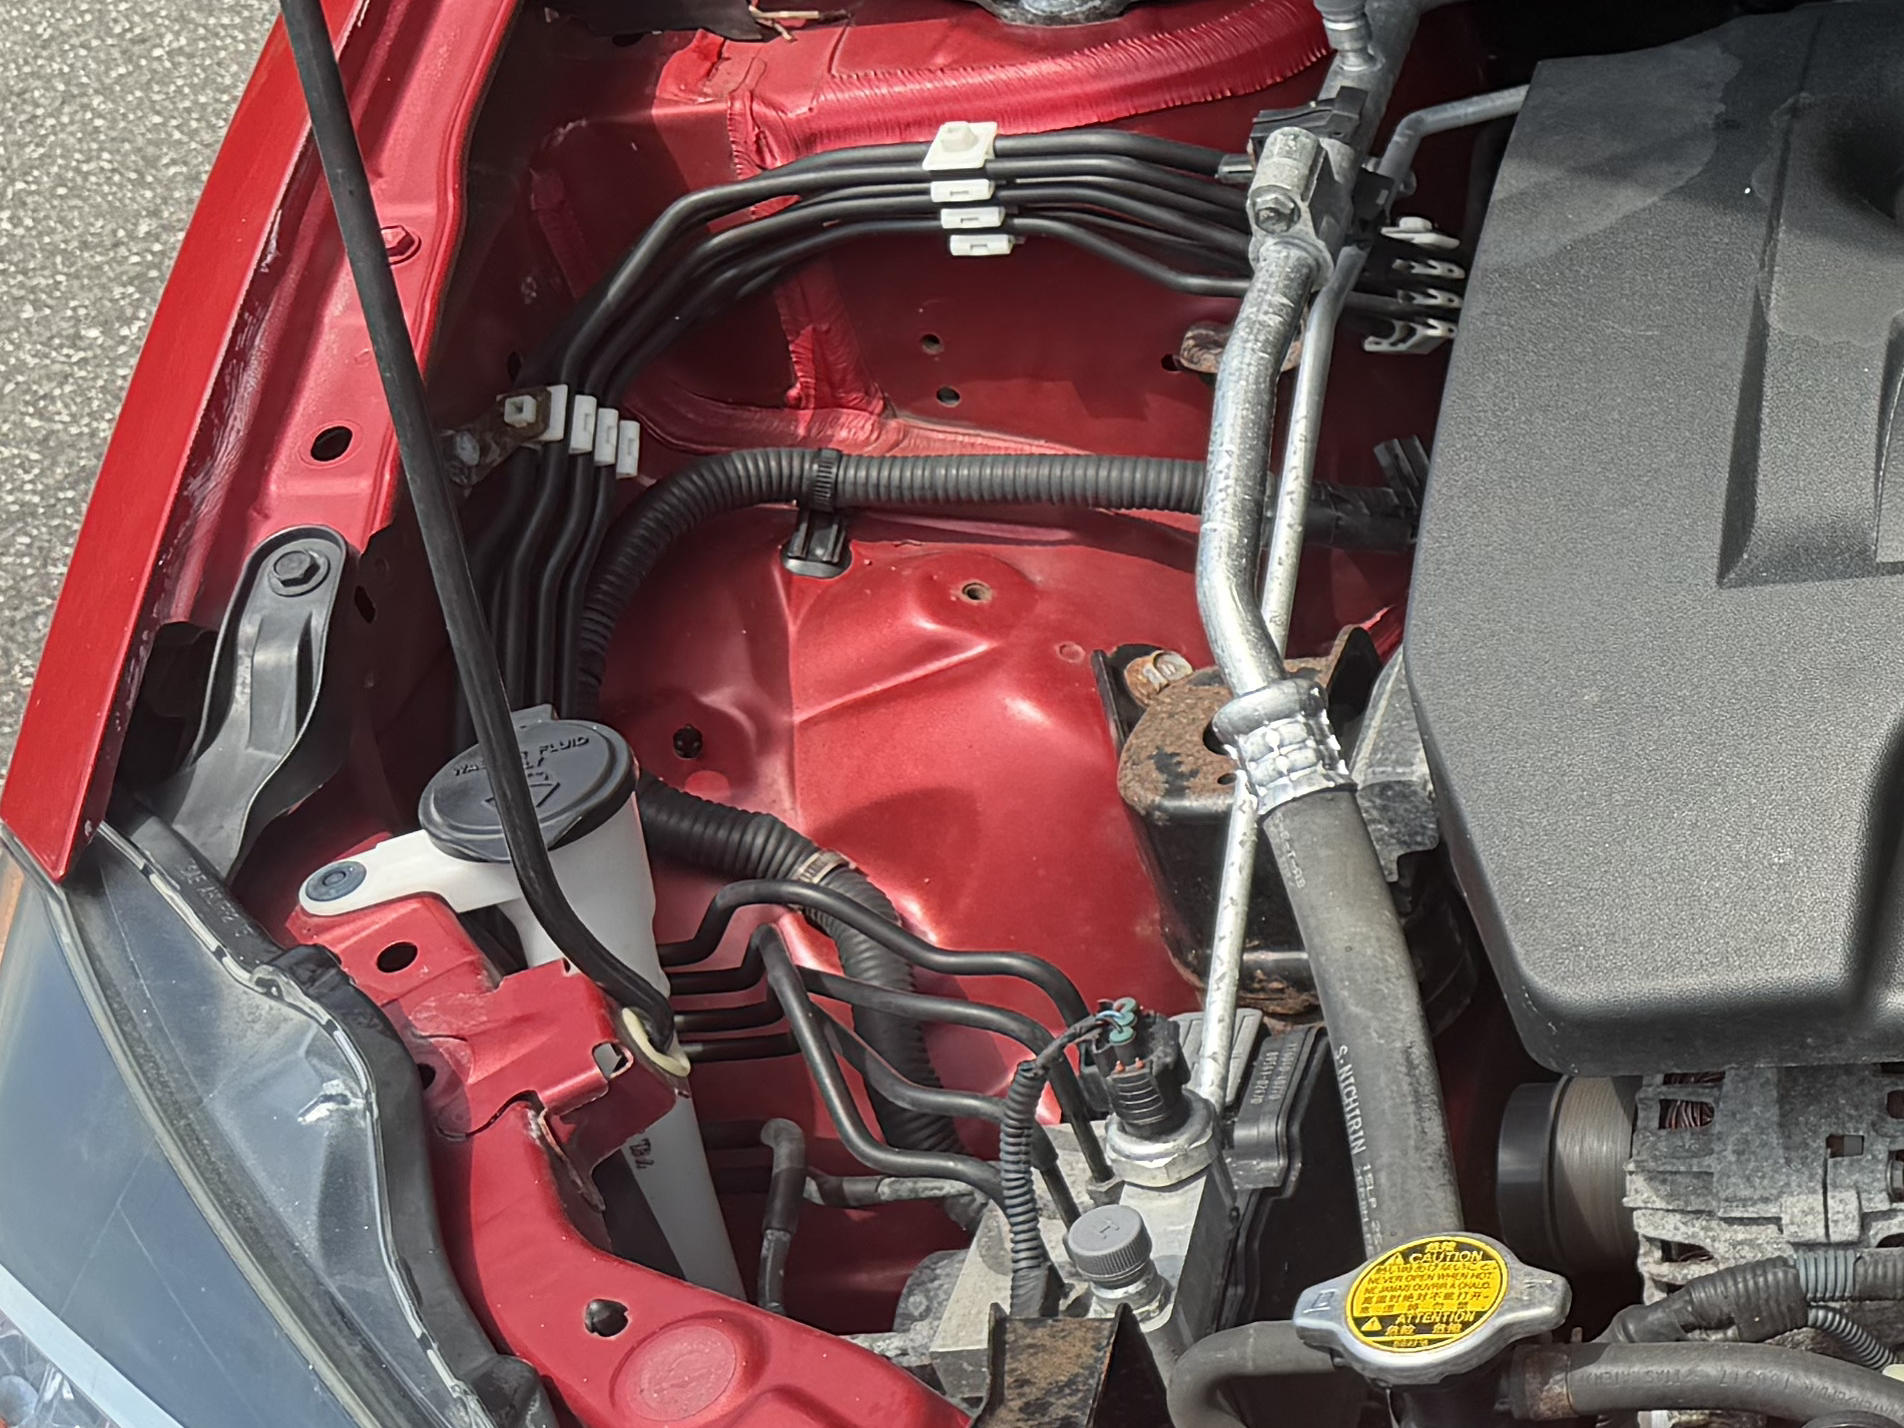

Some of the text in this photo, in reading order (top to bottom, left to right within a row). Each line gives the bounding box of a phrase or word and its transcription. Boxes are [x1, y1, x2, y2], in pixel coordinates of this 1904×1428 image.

[539, 736, 590, 756] FLUID
[1409, 1250, 1484, 1264] CAUTION
[1367, 1274, 1405, 1285] NEVER
[1405, 1273, 1437, 1283] OPEN
[1438, 1272, 1469, 1282] WHEN
[1395, 1311, 1476, 1325] ATTENTION
